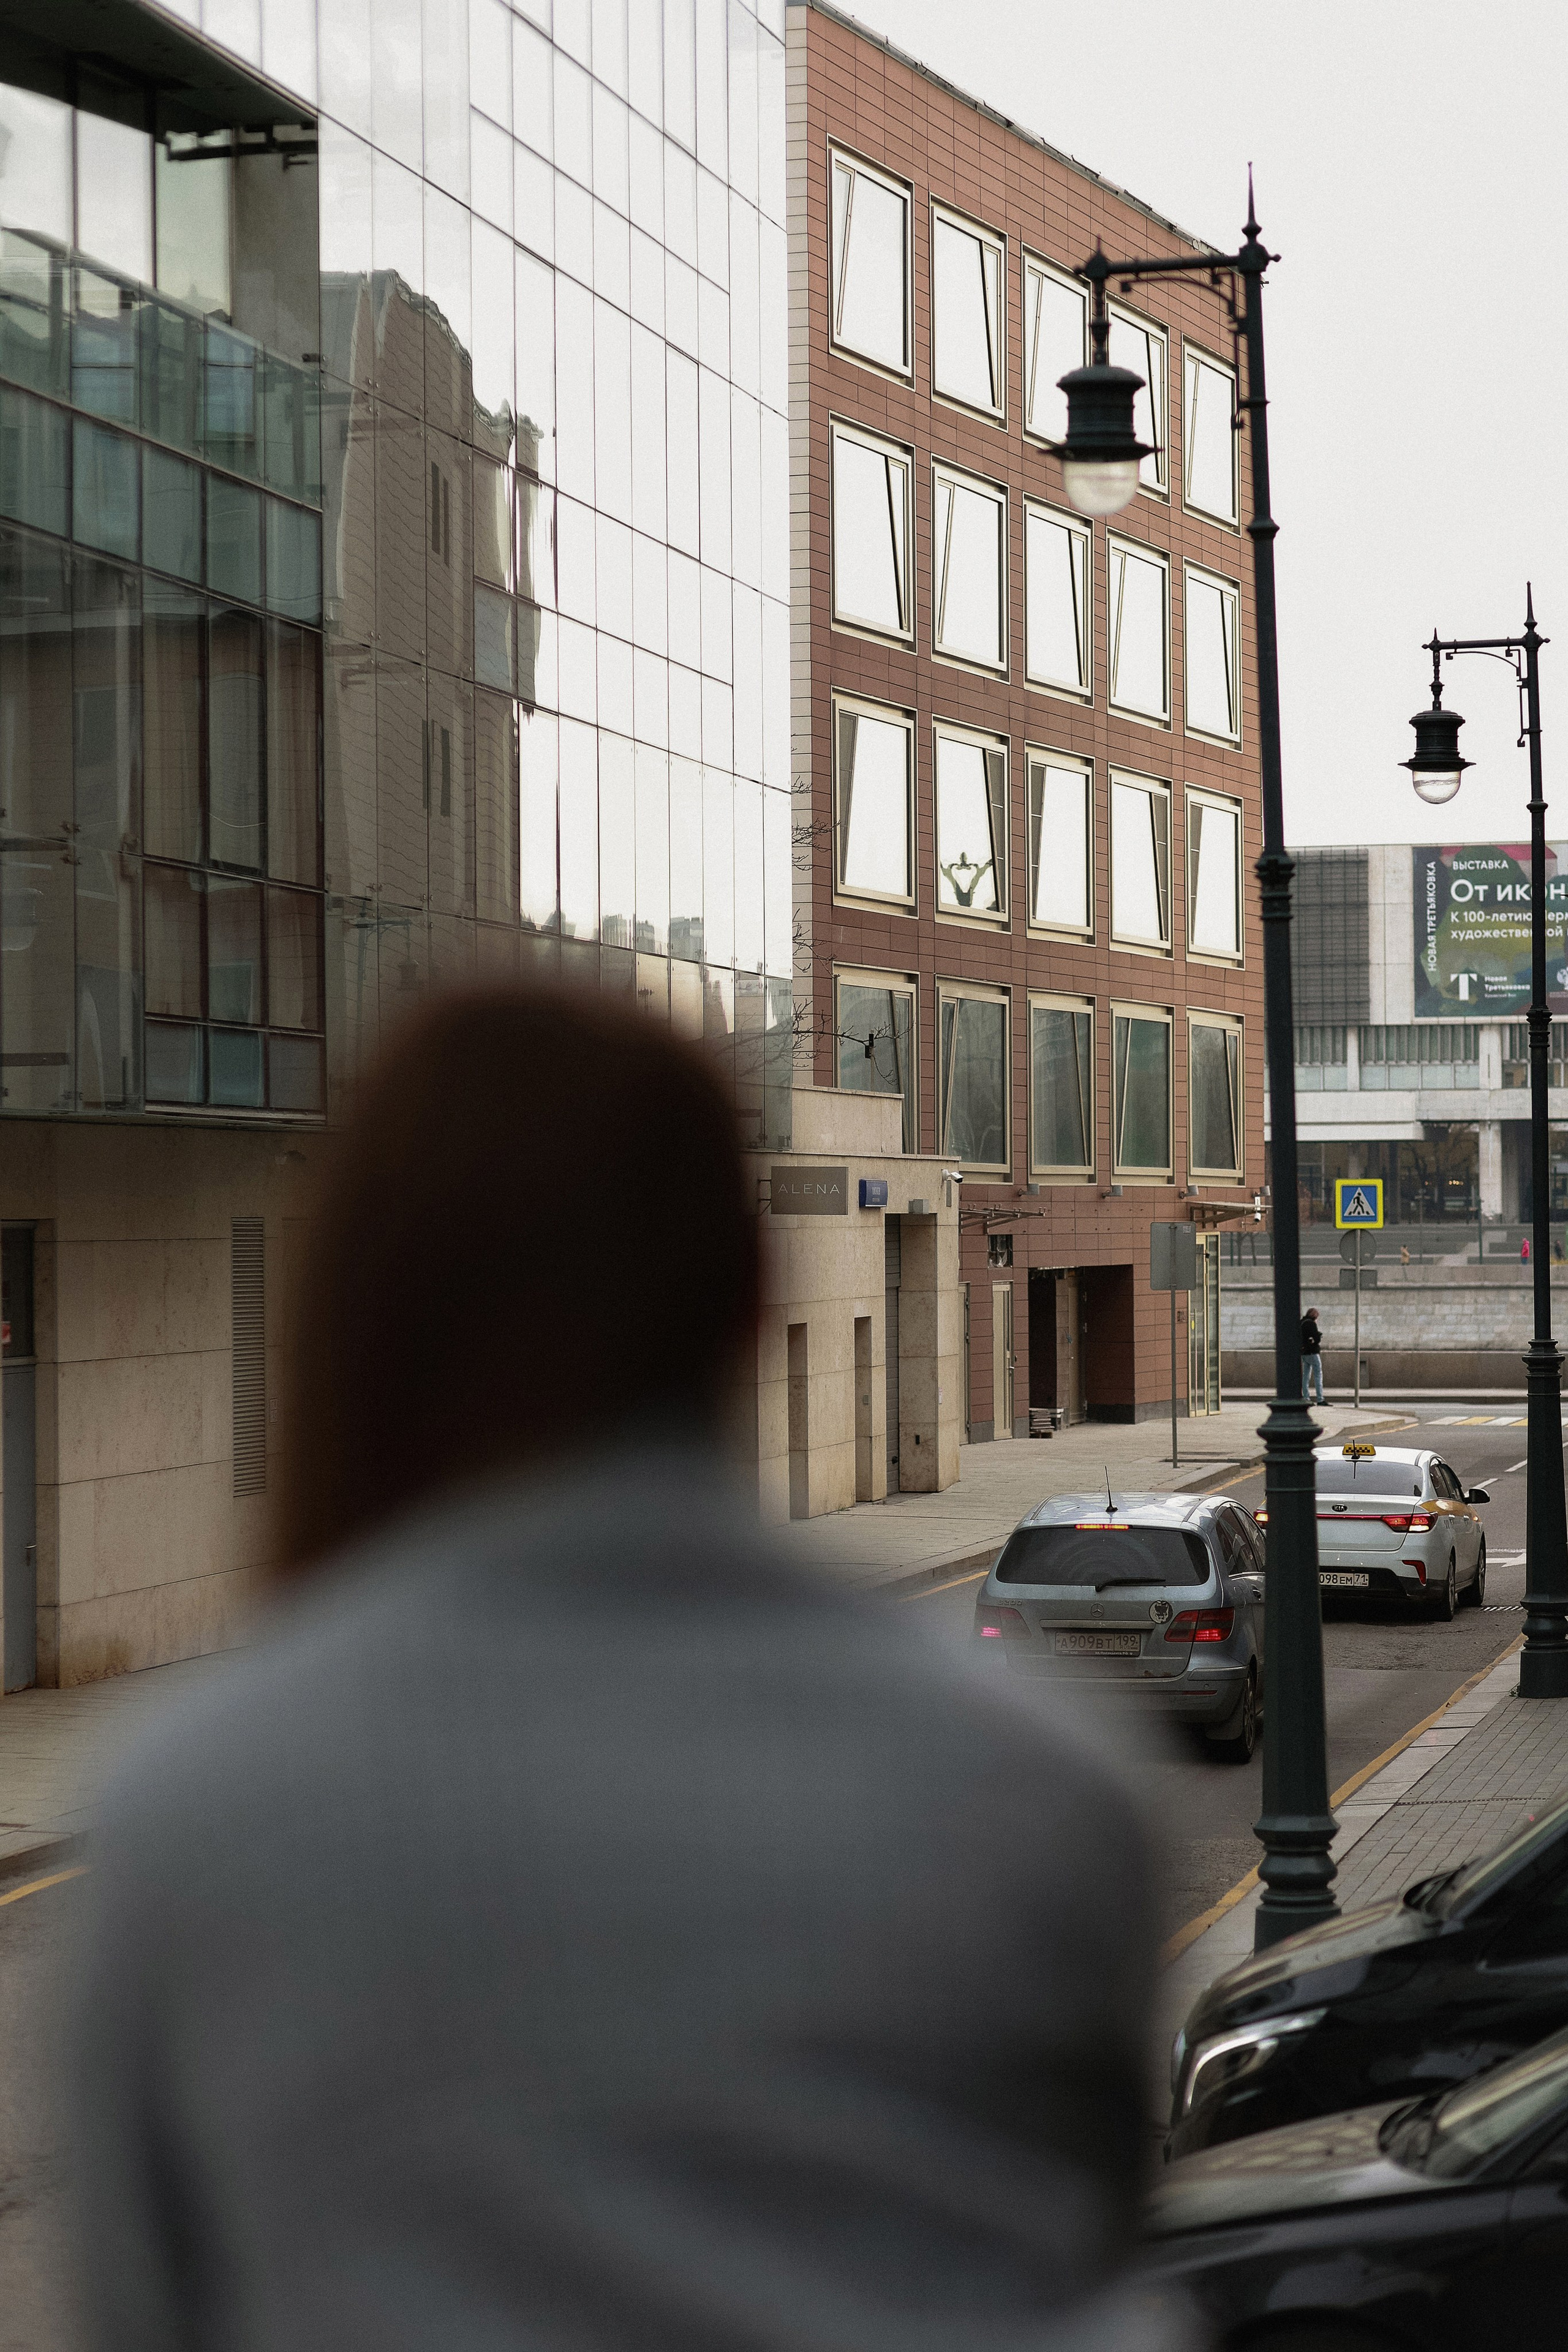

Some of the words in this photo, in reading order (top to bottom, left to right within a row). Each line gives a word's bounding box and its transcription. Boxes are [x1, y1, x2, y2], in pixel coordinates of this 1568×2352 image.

[1452, 860, 1509, 870] ВЫСТАВКА
[1426, 861, 1436, 933] ТРЕТЬЯКОВКА
[1450, 878, 1488, 902] От
[1496, 883, 1566, 901] икн
[1450, 911, 1460, 922] К
[1463, 911, 1532, 922] 100-летию
[1451, 925, 1563, 941] художествеой
[1427, 935, 1436, 971] НОВАЯ
